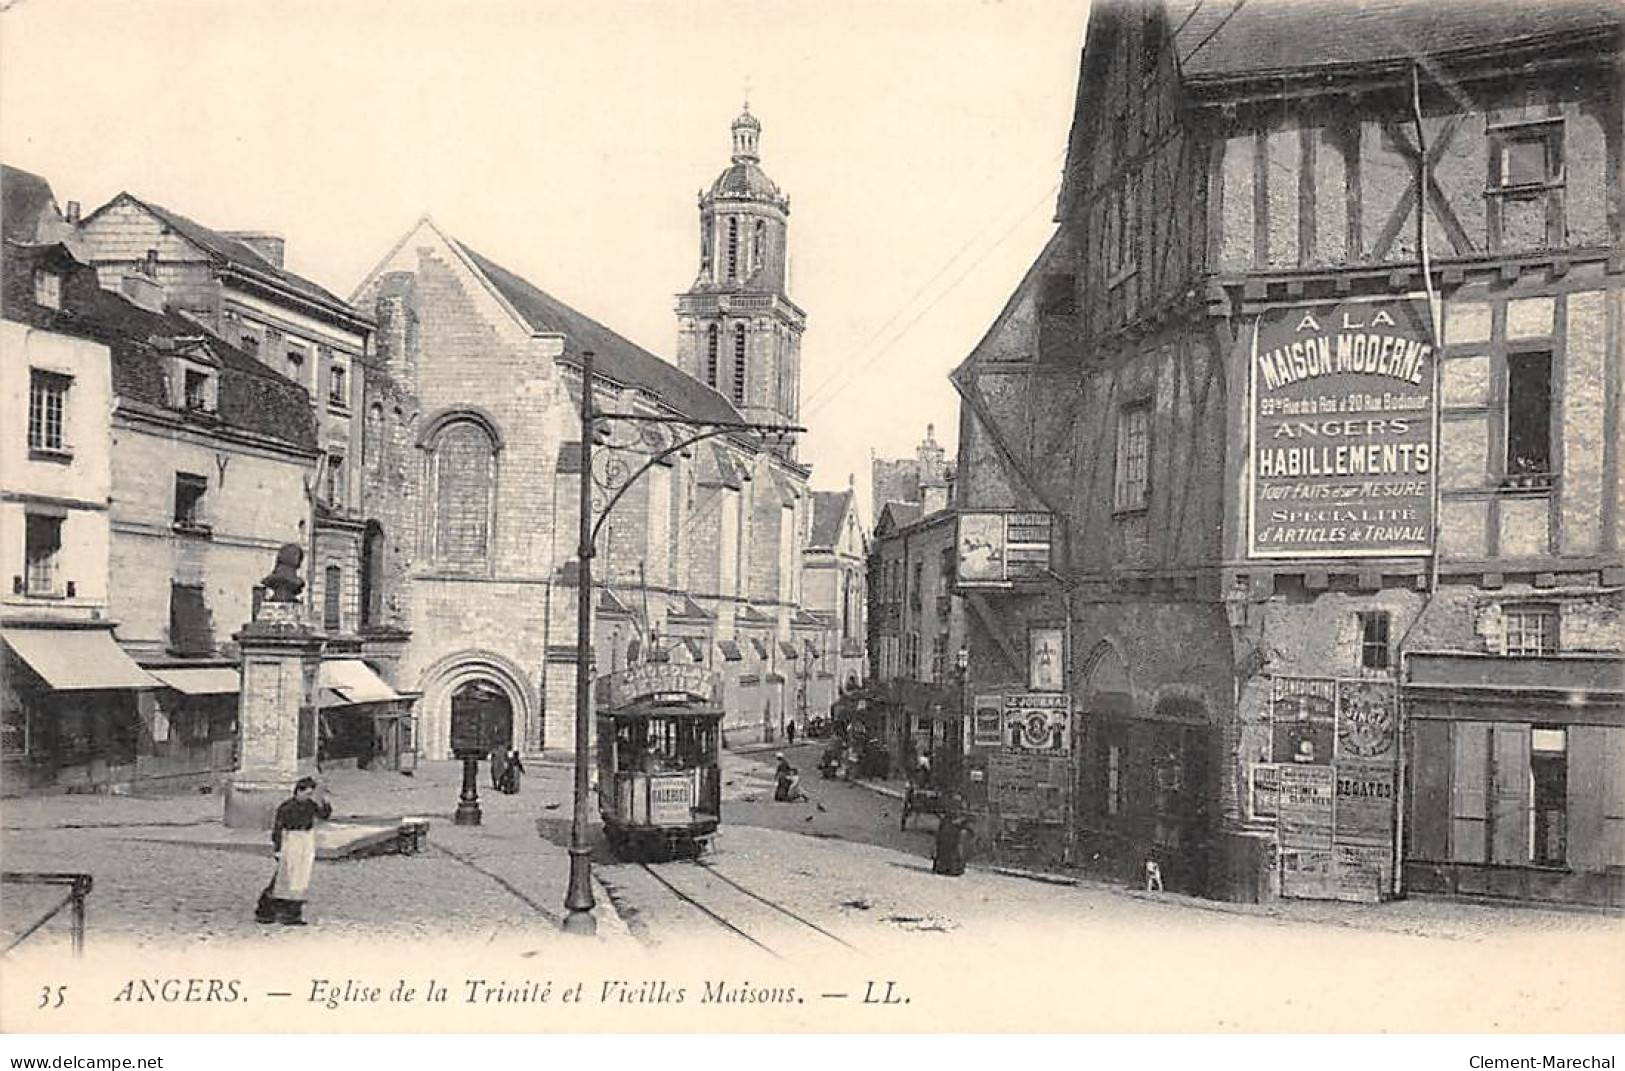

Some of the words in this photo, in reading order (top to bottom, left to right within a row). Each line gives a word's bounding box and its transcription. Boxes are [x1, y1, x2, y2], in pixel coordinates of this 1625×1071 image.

[1342, 310, 1396, 330] LA
[1259, 335, 1332, 391] MAISON
[1337, 333, 1432, 384] MODERNE
[1273, 418, 1410, 439] ANGERS
[1259, 443, 1430, 476] HABILLEMENTS
[1360, 480, 1427, 498] MESURE
[1364, 523, 1426, 541] TRAVAIL
